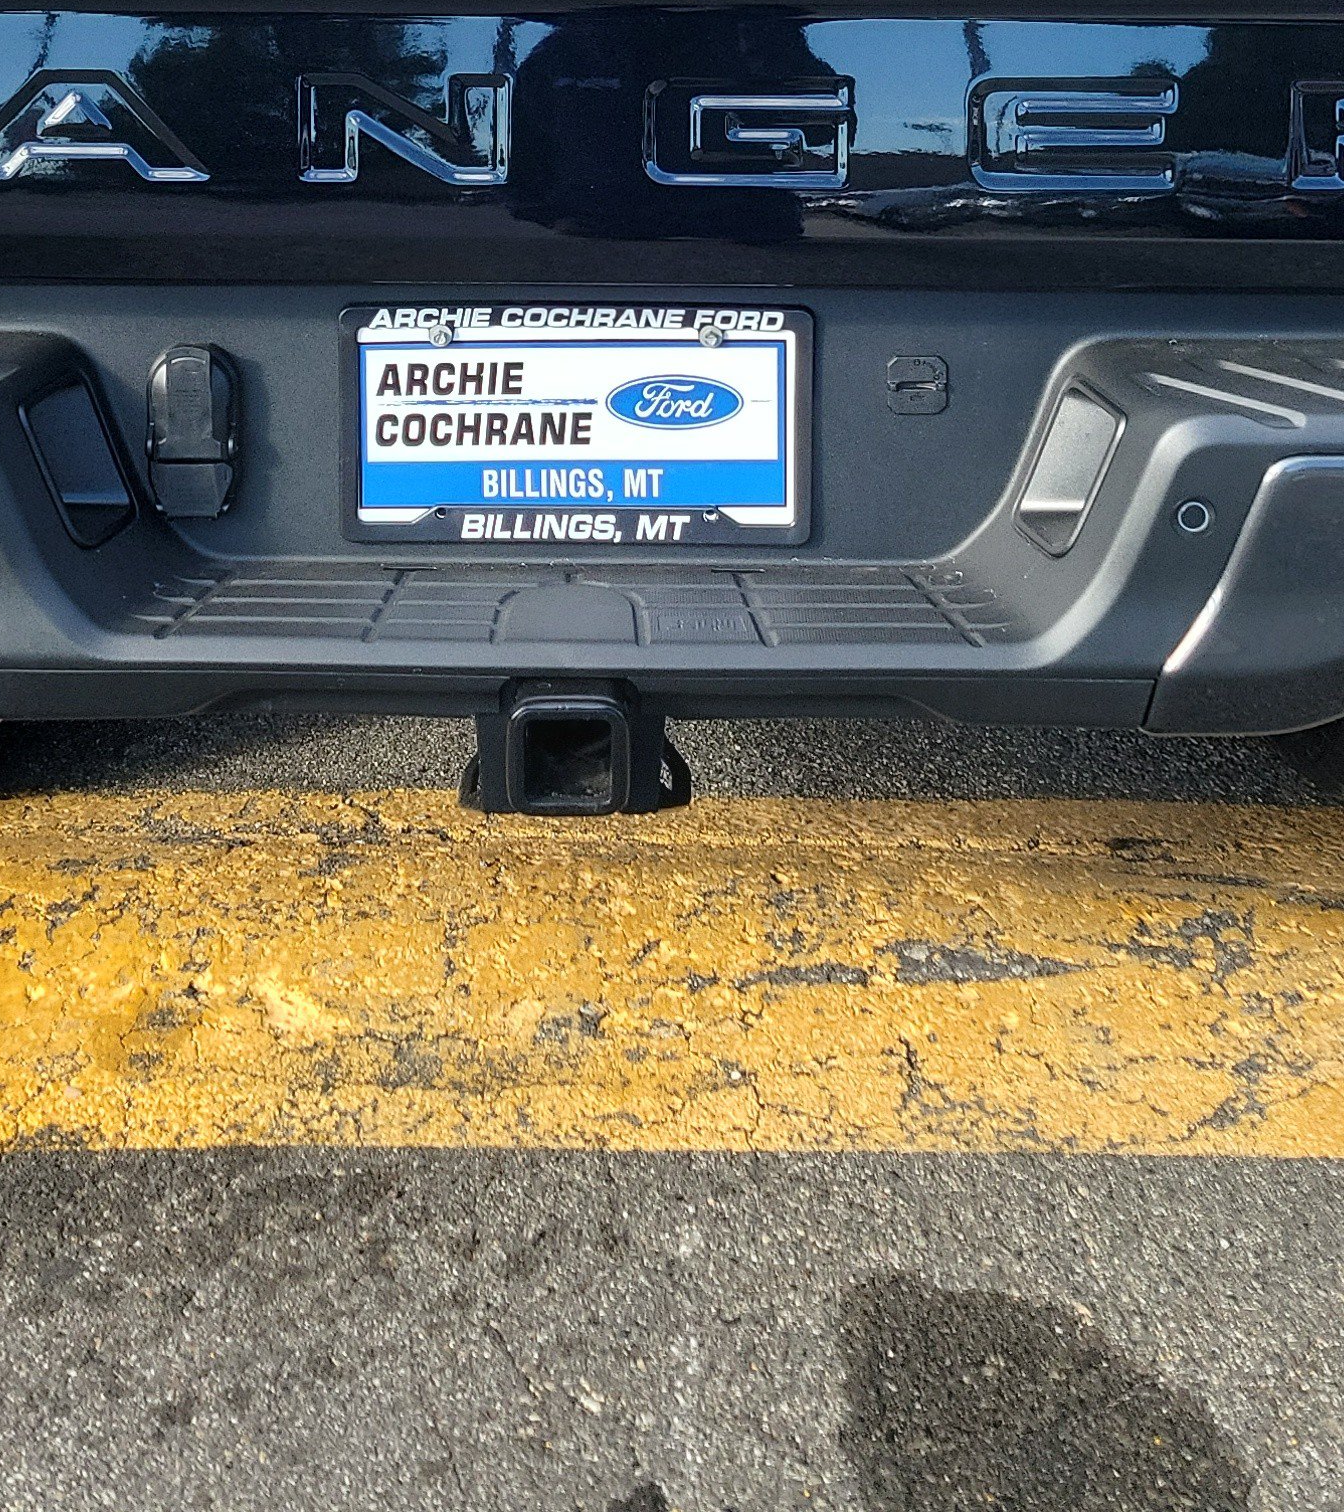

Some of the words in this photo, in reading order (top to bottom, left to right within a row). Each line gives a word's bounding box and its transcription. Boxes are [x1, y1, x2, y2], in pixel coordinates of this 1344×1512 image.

[369, 307, 491, 329] ARCHIE
[500, 308, 684, 330] COCHRANE
[693, 310, 785, 332] FORD
[376, 361, 524, 397] ARCHIE
[634, 382, 714, 420] Ford
[375, 412, 593, 447] COCHRANE
[482, 468, 613, 502] BILLINGS,
[623, 468, 664, 498] MT
[461, 513, 622, 543] BILLINGS,
[636, 515, 690, 541] MT
